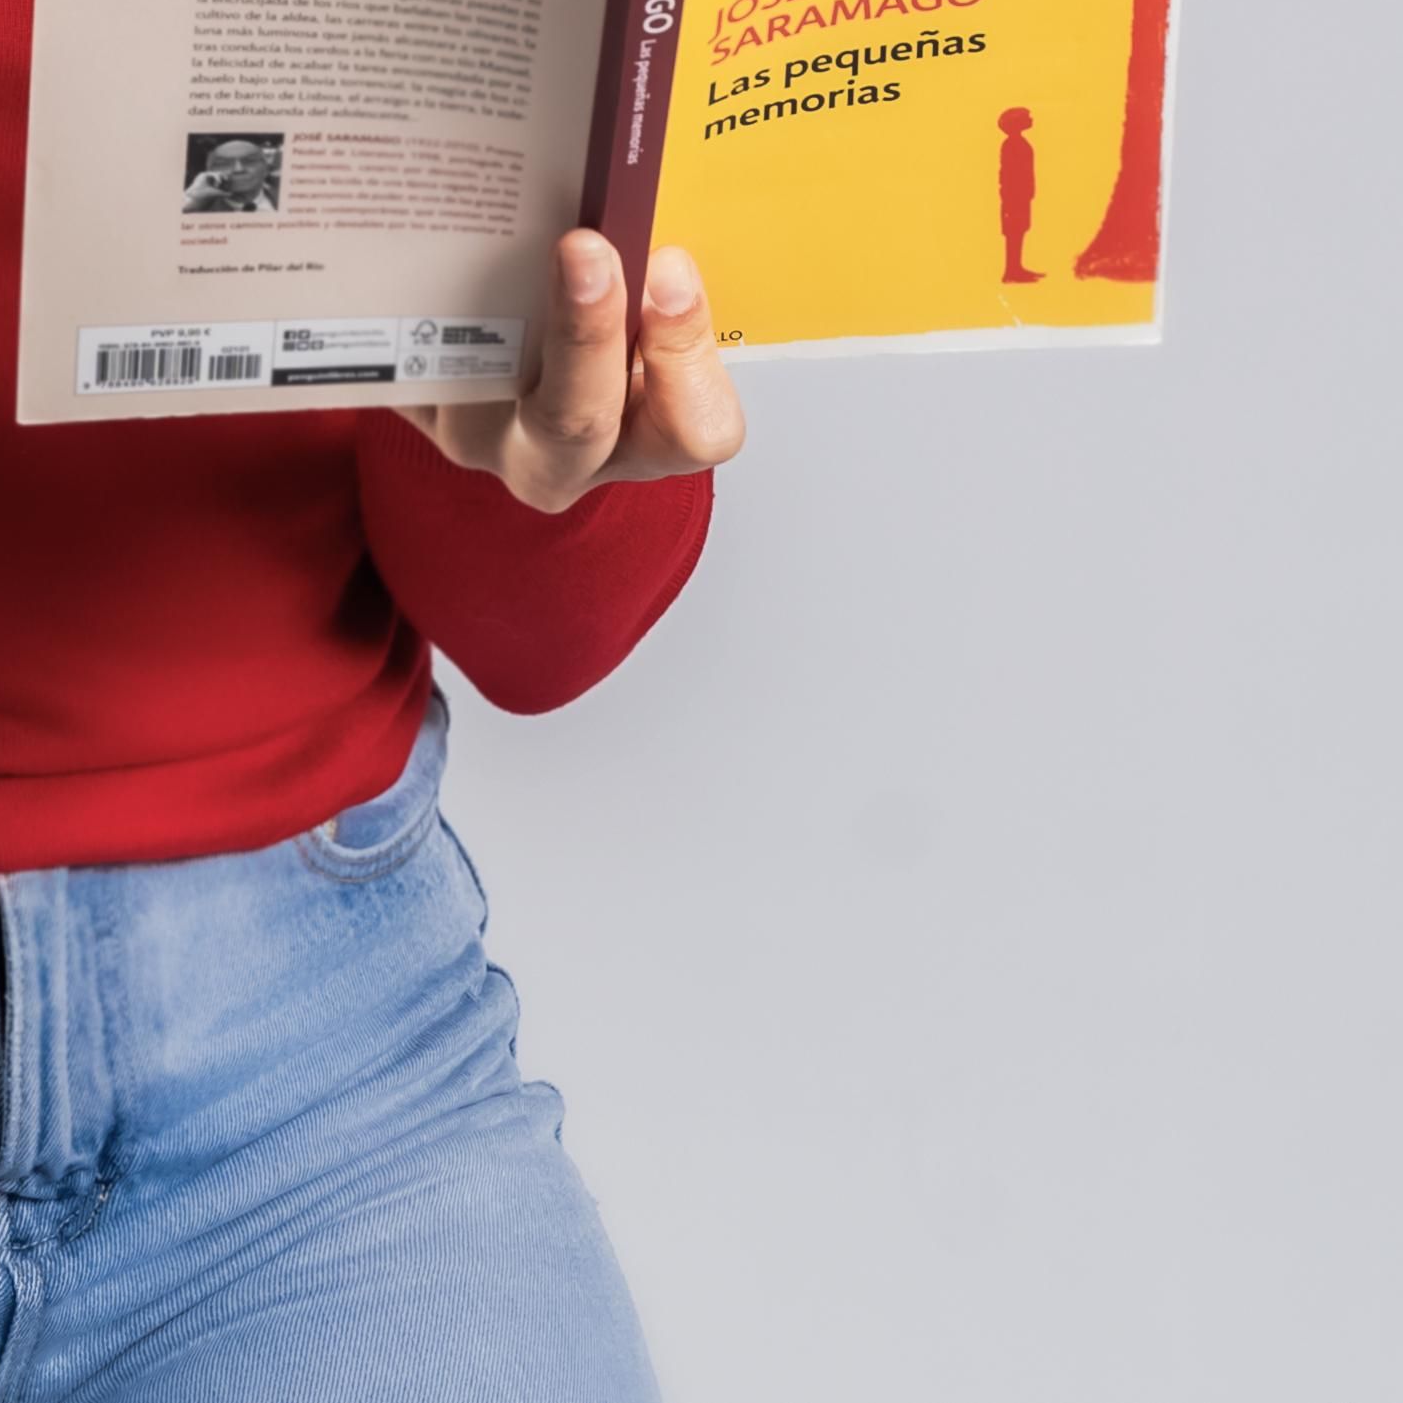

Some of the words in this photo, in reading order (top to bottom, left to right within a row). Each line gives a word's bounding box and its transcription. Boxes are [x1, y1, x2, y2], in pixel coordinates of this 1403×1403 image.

[640, 39, 657, 59] Las
[708, 67, 771, 106] Las
[784, 30, 987, 88] pequeñas
[704, 80, 901, 140] memorias
[627, 112, 644, 165] memorias
